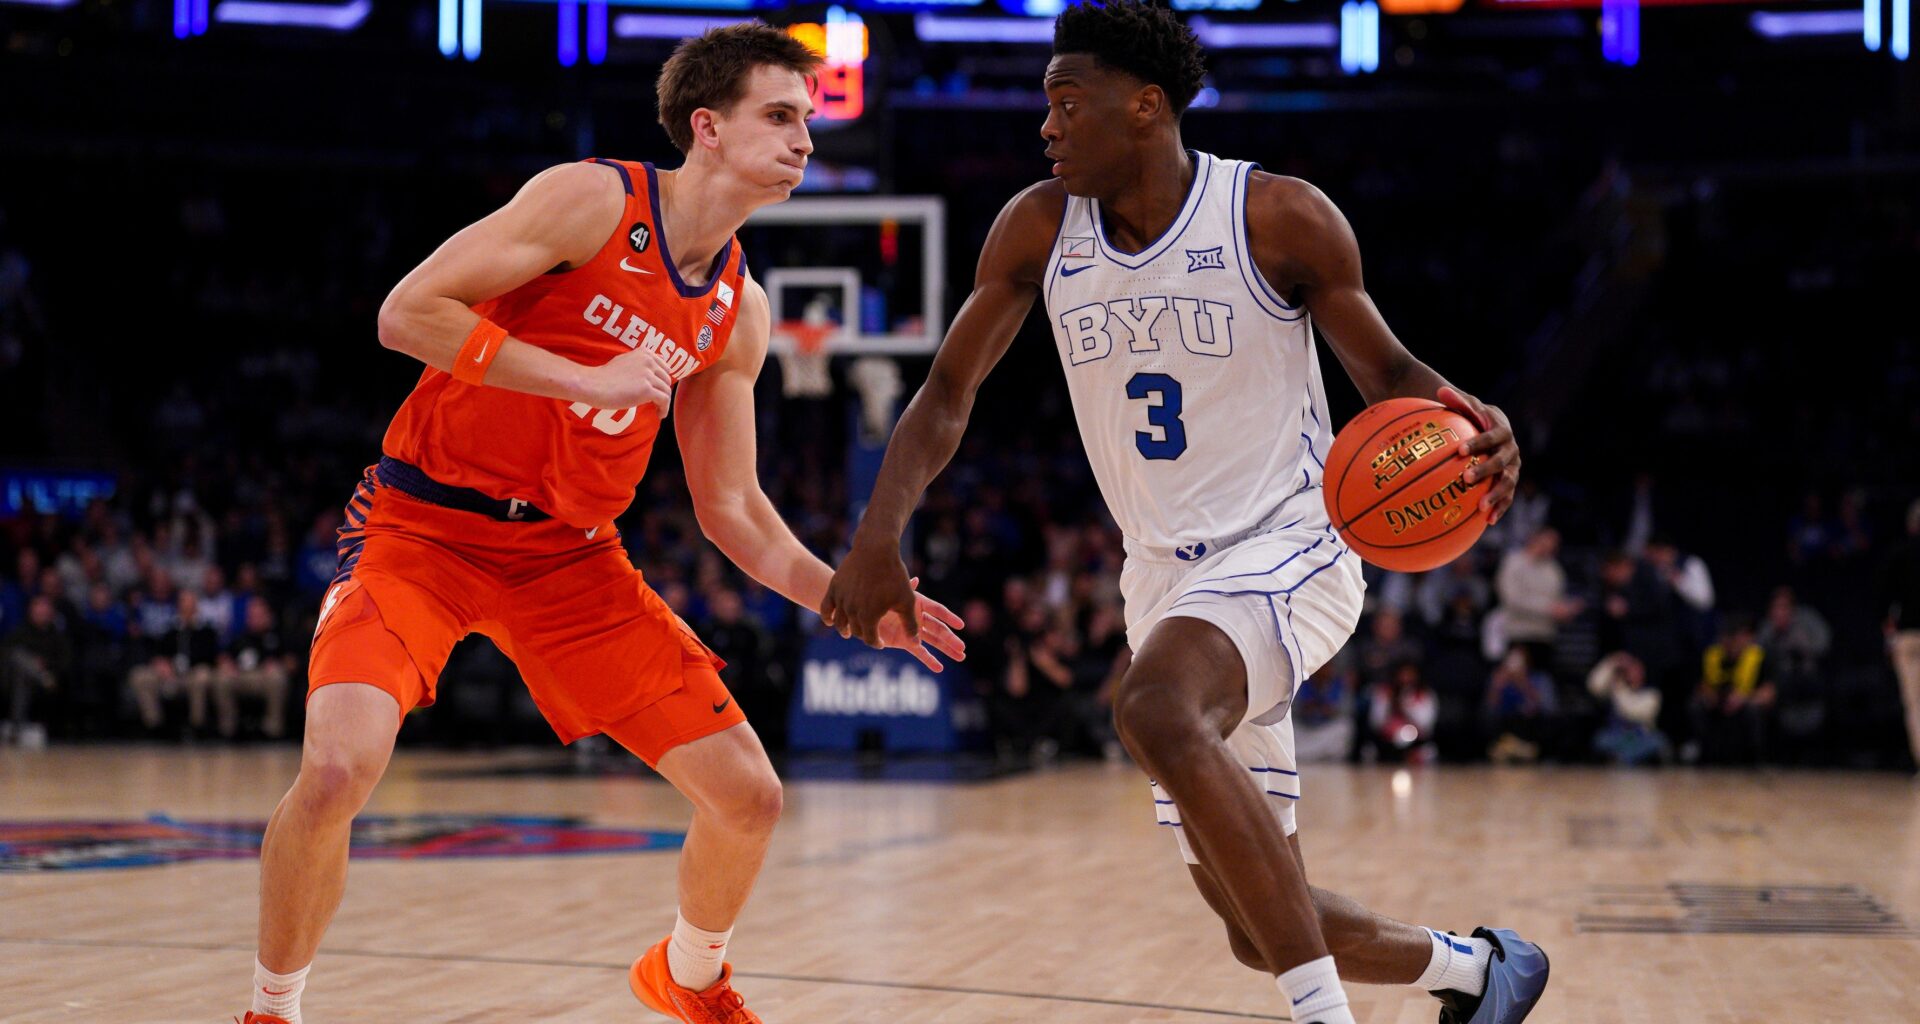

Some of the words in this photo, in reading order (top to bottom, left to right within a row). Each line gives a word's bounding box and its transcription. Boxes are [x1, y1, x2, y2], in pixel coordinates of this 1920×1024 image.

[630, 227, 649, 251] 41
[583, 294, 701, 380] CLEMSON
[1060, 296, 1233, 366] BYU
[1126, 372, 1187, 460] 3
[1372, 427, 1459, 490] LEGACY
[507, 498, 528, 520] C
[1385, 458, 1480, 535] ALDING
